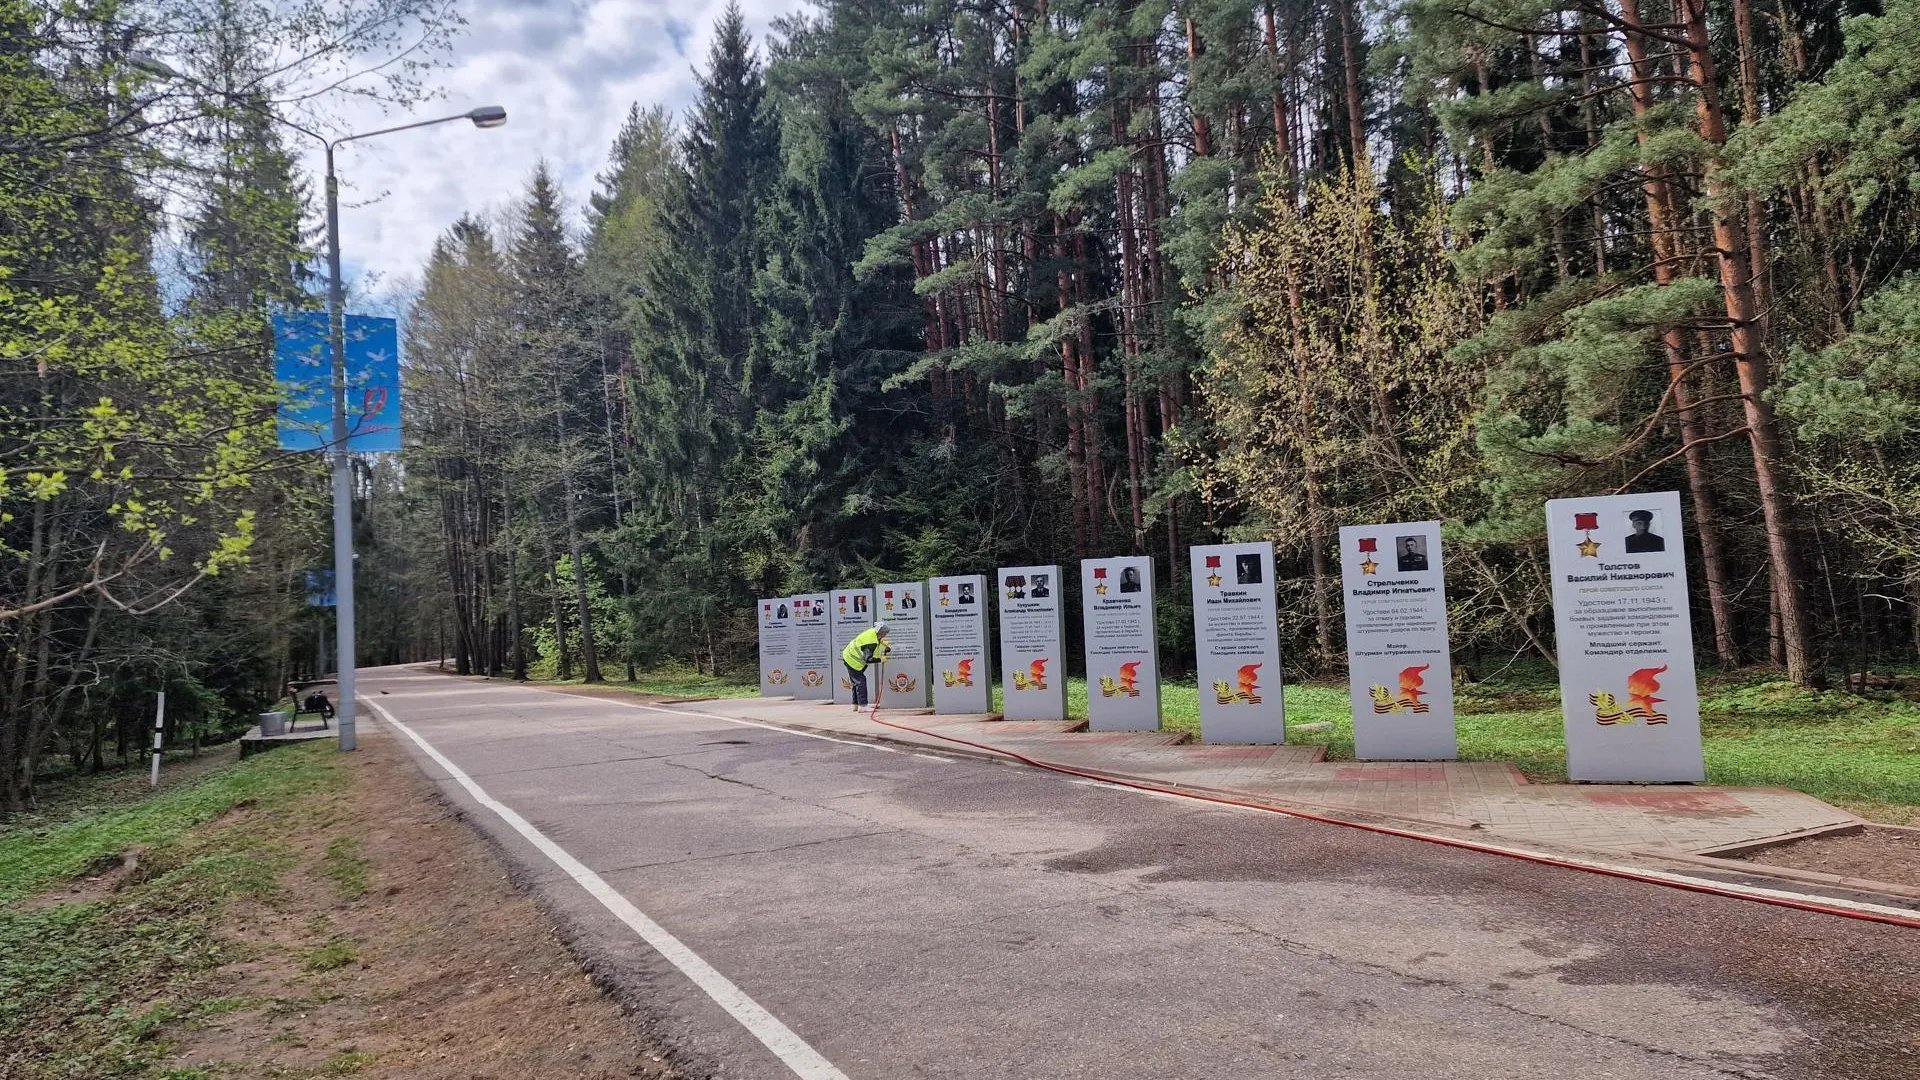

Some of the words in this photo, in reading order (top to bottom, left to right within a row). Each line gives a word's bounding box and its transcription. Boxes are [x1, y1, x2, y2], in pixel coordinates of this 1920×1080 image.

[1598, 563, 1641, 571] Толстов
[1567, 574, 1608, 582] Василий
[1610, 572, 1674, 580] Никанорович
[1367, 579, 1419, 587] Стрельченко
